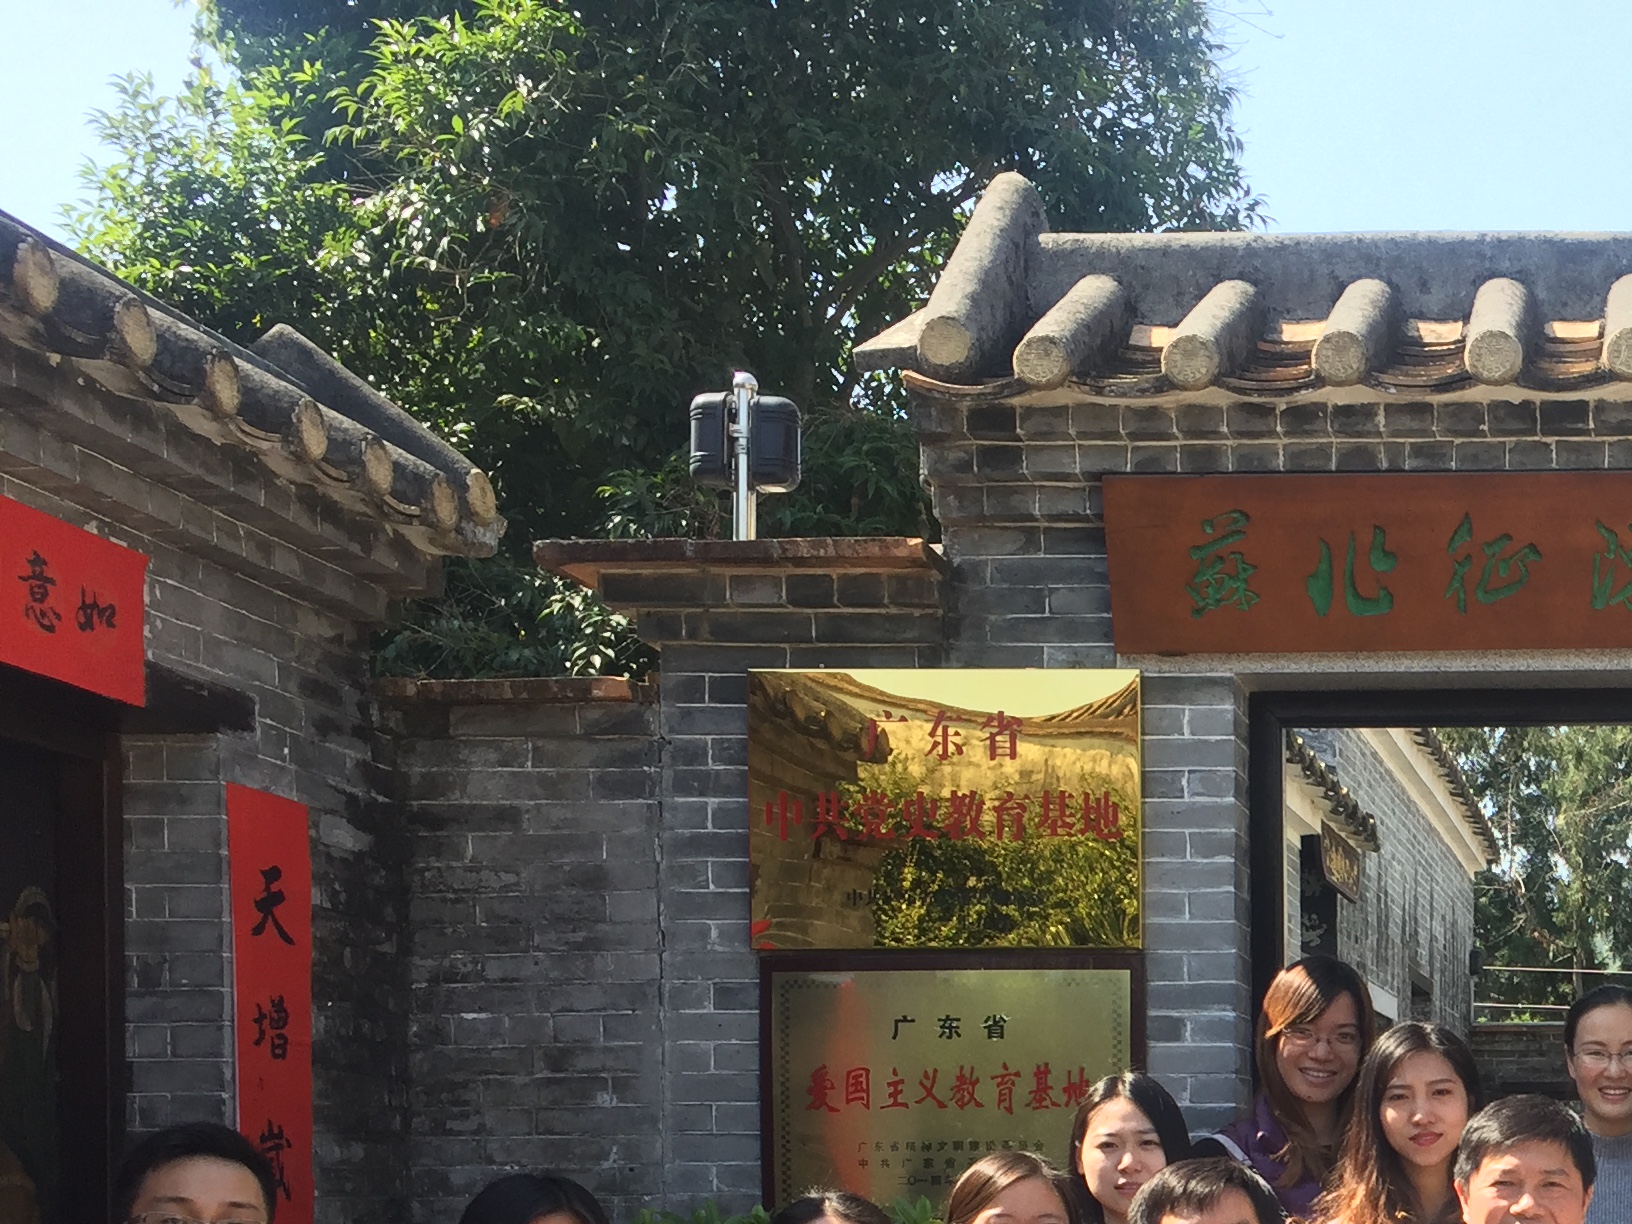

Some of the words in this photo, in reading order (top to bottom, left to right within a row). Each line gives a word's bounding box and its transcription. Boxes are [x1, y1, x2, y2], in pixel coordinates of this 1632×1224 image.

[865, 710, 1025, 763] 广东省
[763, 789, 1126, 843] 中共党史教育基地
[892, 1013, 1007, 1041] 广东省
[805, 1063, 1090, 1115] 爱国主义教育基地
